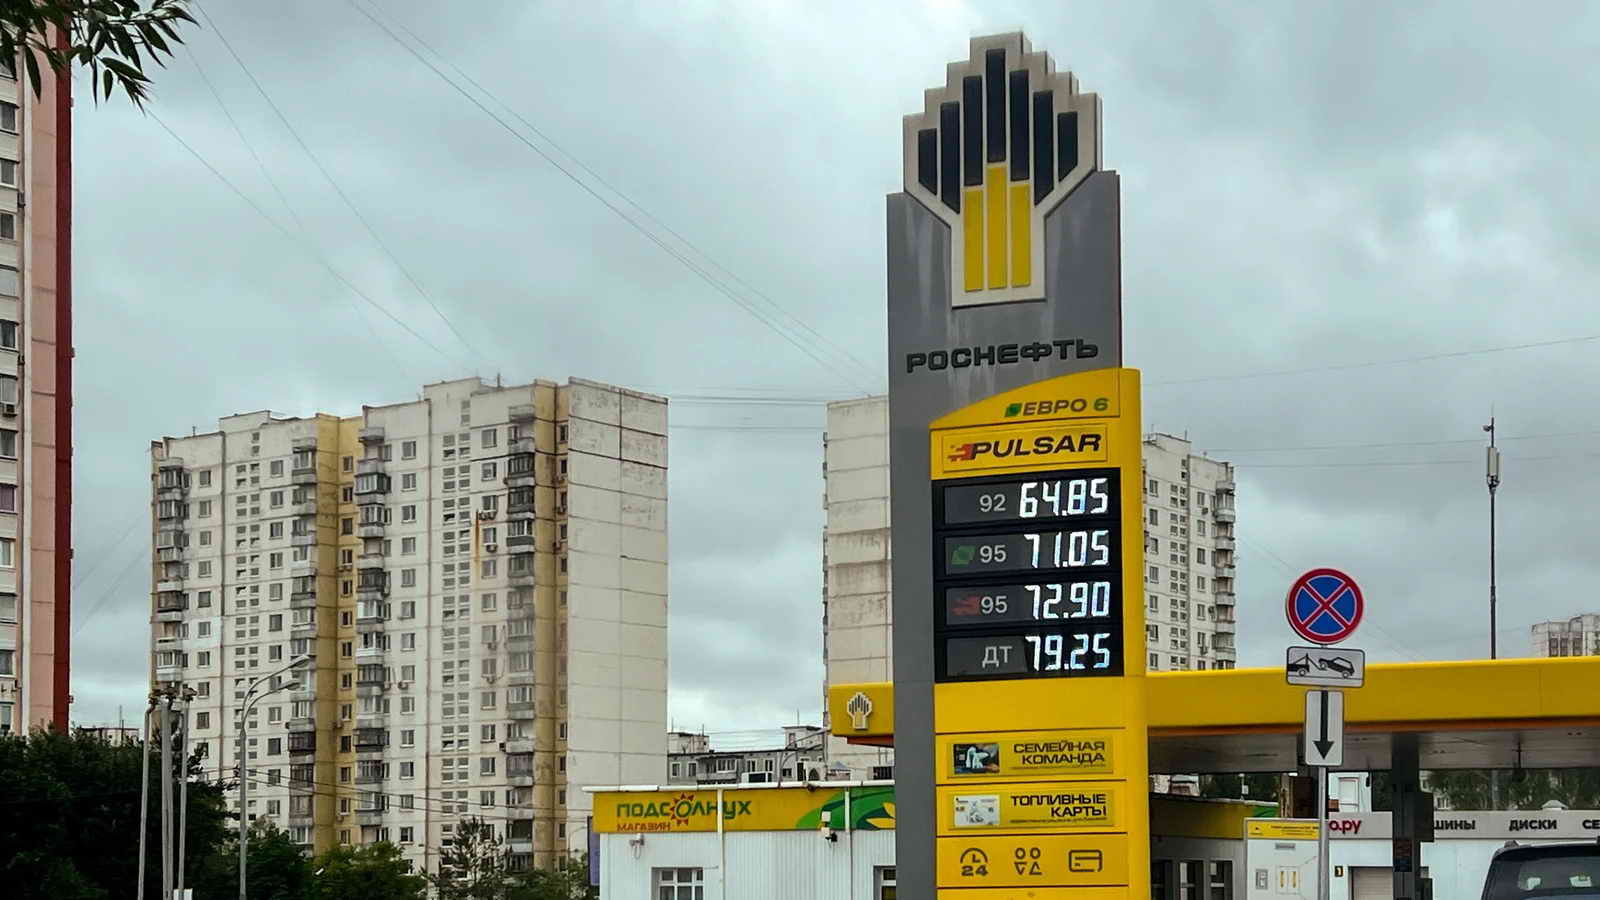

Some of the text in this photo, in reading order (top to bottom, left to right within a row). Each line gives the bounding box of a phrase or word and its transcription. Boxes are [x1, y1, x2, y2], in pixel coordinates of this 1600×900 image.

[906, 339, 1099, 373] РОСНЕФТЬ
[1022, 398, 1109, 416] ЕВРО 6
[971, 433, 1103, 461] PULSAR
[979, 478, 1109, 518] 92 64.85
[979, 529, 1109, 568] 95 71.05
[980, 581, 1111, 620] 95 72.90
[981, 632, 1111, 671] ДТ 79.25
[1013, 740, 1105, 753] СЕМЕЙНАЯ
[1021, 752, 1105, 765] КОМАНДА
[1010, 793, 1106, 807] ТОПЛИВНЫЕ
[1050, 805, 1107, 817] КАРТЫ
[616, 822, 672, 832] МАГАЗИН
[1508, 819, 1557, 832] ДИСКИ
[961, 865, 989, 877] 24
